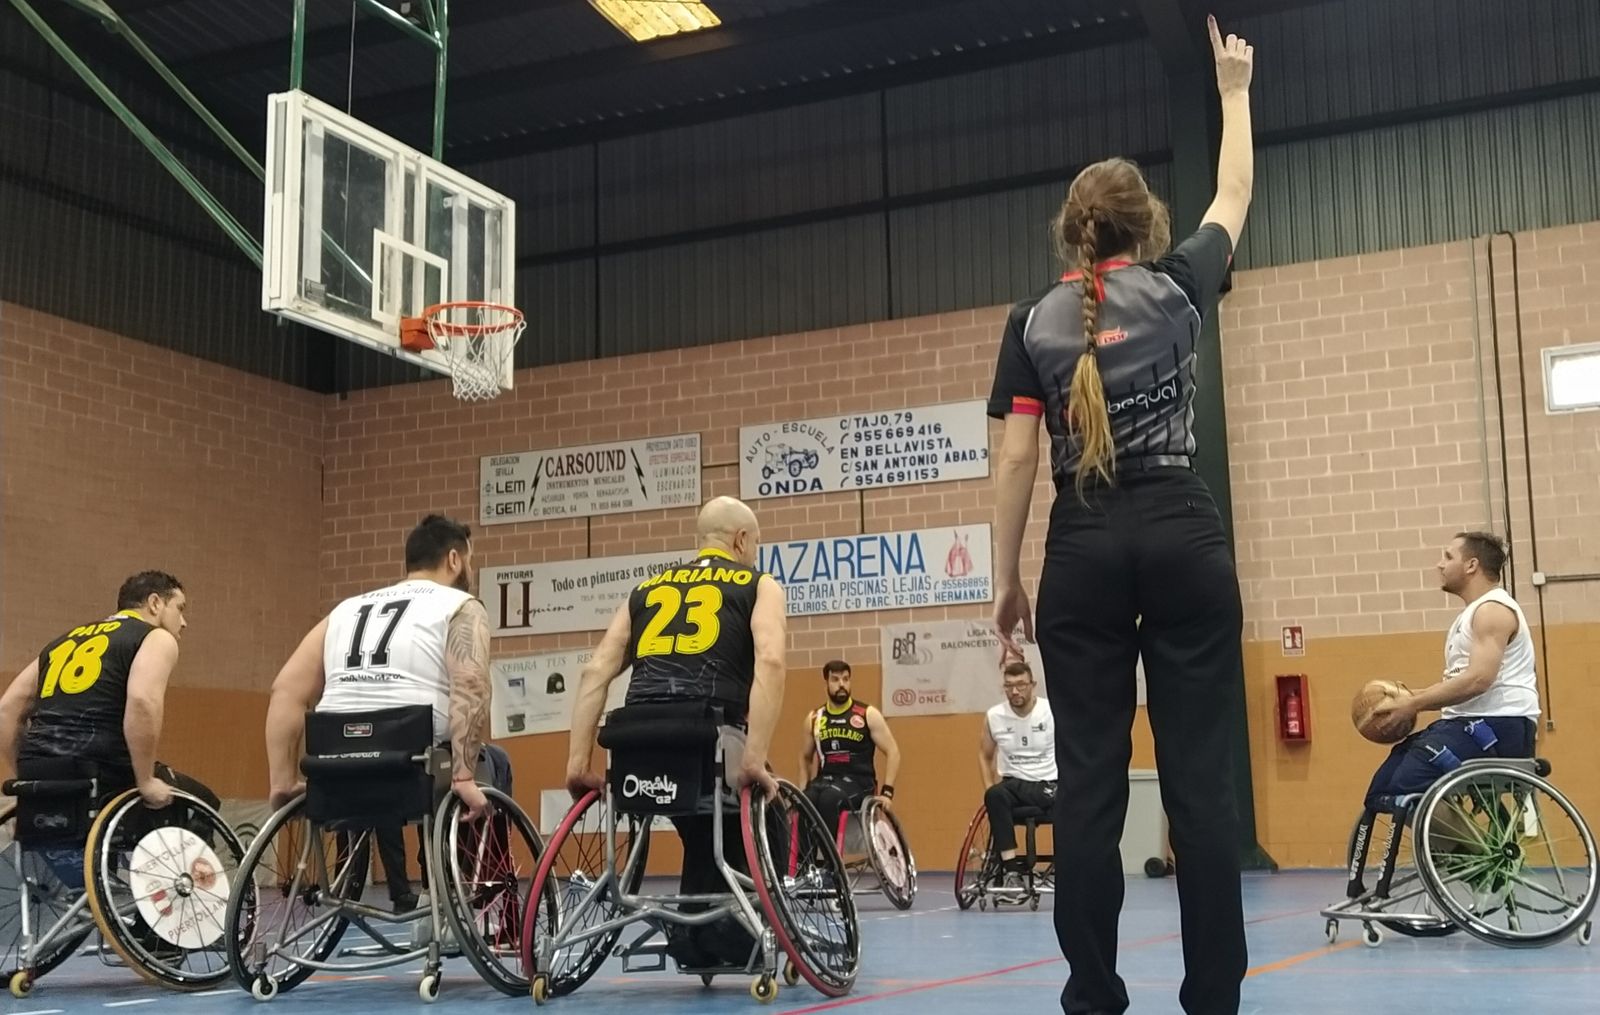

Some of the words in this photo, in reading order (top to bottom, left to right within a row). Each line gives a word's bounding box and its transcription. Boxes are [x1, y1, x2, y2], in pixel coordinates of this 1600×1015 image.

[1107, 378, 1177, 414] bequal
[840, 447, 859, 460] EN
[865, 437, 953, 457] BELLAVISTA
[545, 449, 626, 478] CARSOUND
[884, 453, 938, 470] ANTONIO
[496, 480, 525, 494] LEM
[758, 477, 824, 496] ONDA
[496, 501, 525, 515] GEM
[497, 570, 534, 580] PINTURAS
[552, 577, 575, 592] Todo
[577, 576, 588, 588] en
[590, 568, 630, 588] pinturas
[633, 566, 645, 578] en
[637, 567, 753, 591] MARIANO
[809, 583, 836, 600] PARA
[893, 576, 932, 593] LEJIAS
[934, 588, 988, 603] HERMANAS
[68, 621, 121, 637] PATO
[636, 585, 723, 659] 23
[344, 598, 412, 671] 17
[967, 629, 987, 637] LIGA
[940, 640, 999, 650] BALONCESTO
[40, 634, 109, 698] 18
[502, 661, 537, 673] SEPARA
[547, 656, 567, 668] TUS
[918, 694, 947, 704] ONCE
[1021, 736, 1028, 746] 9
[656, 795, 672, 804] G2
